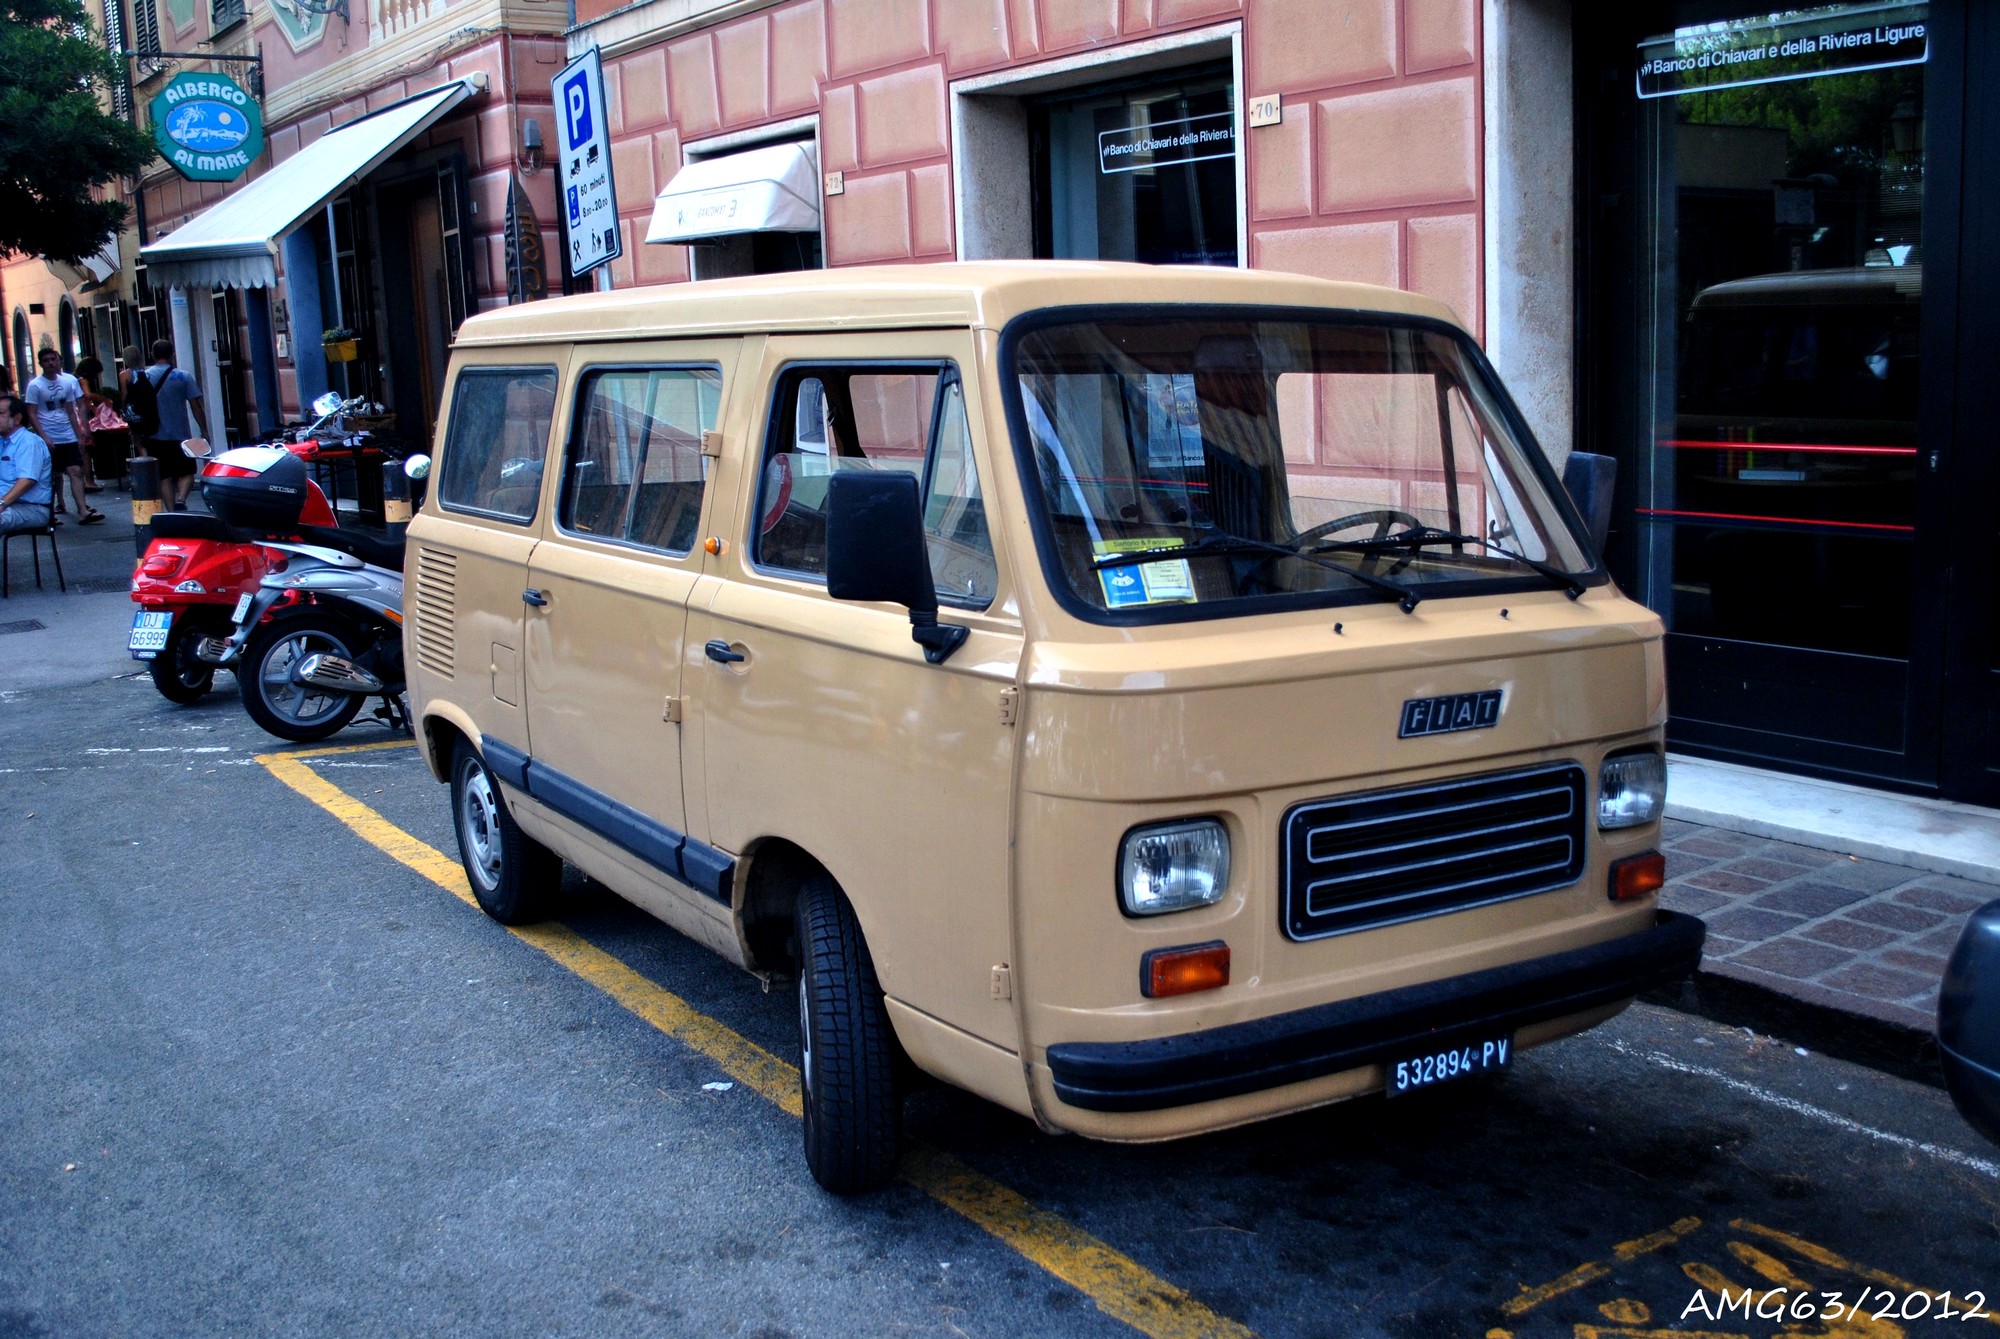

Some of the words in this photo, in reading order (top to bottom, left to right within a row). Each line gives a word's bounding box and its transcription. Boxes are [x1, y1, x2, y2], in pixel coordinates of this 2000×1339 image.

[1653, 58, 1695, 75] Banco
[1697, 55, 1710, 70] di
[1711, 48, 1766, 67] Chiavari
[1768, 46, 1778, 58] e
[1780, 39, 1815, 57] della
[1819, 32, 1872, 52] Riviera
[1875, 23, 1925, 45] Ligure
[165, 82, 246, 105] ALBERGO
[568, 84, 585, 141] P
[1256, 101, 1273, 119] 70
[1109, 143, 1135, 156] Banco
[1134, 139, 1142, 152] di
[1141, 135, 1172, 151] Chiavari
[1172, 138, 1179, 147] e
[1179, 132, 1199, 146] della
[1200, 129, 1229, 143] Riviera
[174, 149, 194, 168] AL
[197, 150, 250, 171] MARE
[581, 184, 588, 196] 60
[590, 172, 606, 191] minuti
[829, 176, 839, 190] 72
[143, 613, 159, 628] DJ
[132, 631, 166, 646] 66999
[1411, 698, 1496, 729] FIAT
[1396, 1047, 1472, 1090] 532894
[1482, 1038, 1508, 1068] PV
